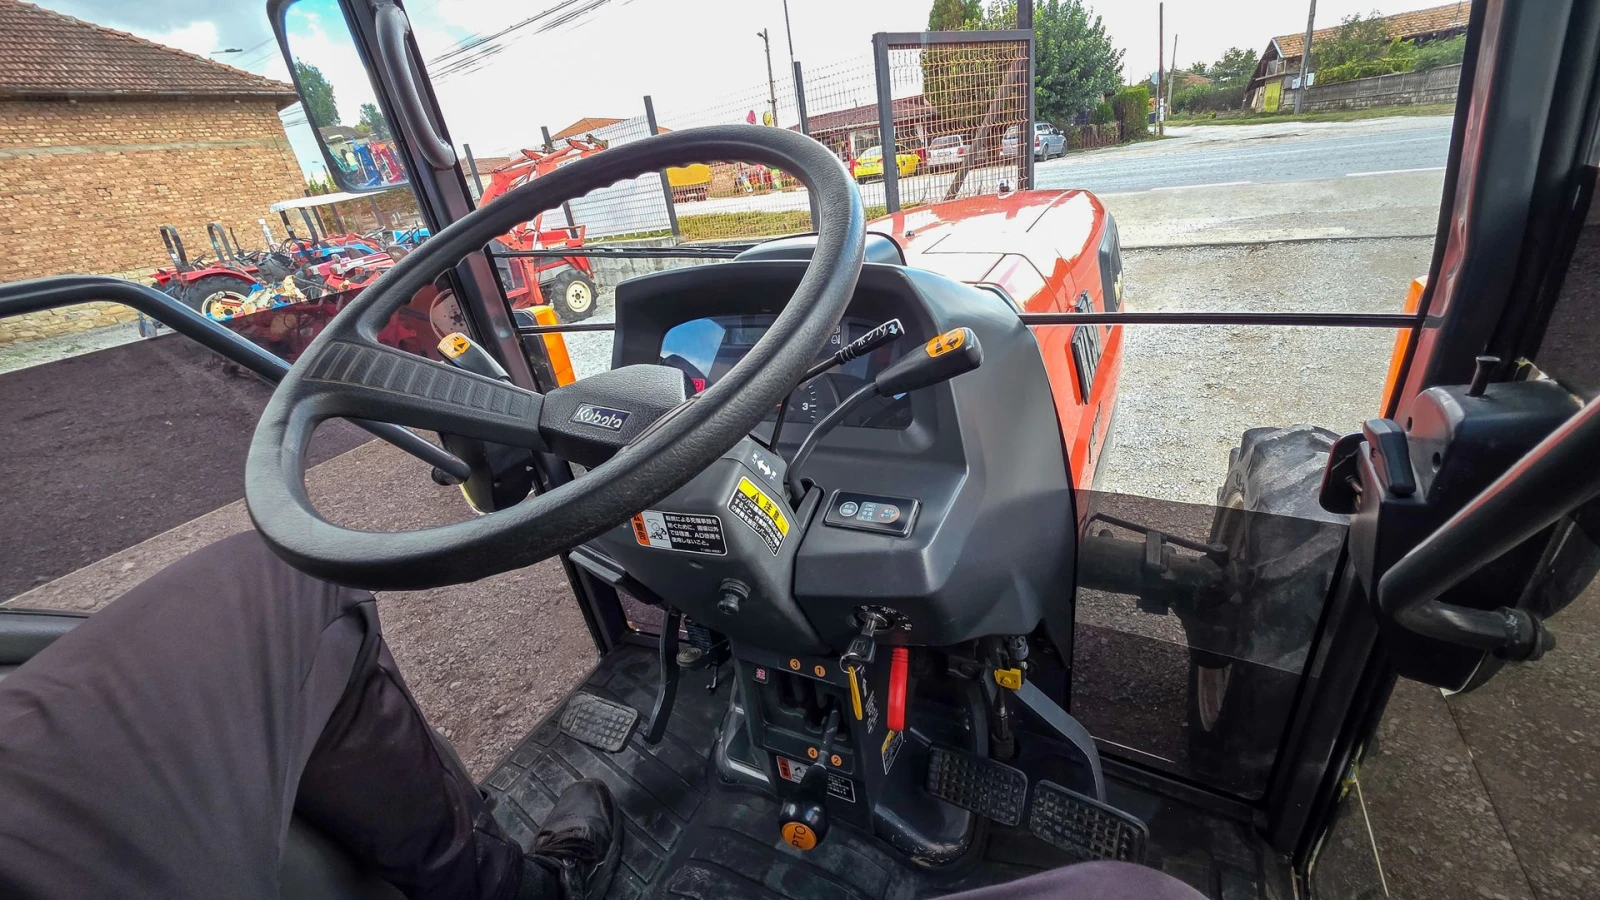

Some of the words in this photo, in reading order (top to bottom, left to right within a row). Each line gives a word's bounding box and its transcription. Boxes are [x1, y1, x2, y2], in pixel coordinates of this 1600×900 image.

[802, 403, 808, 411] 3
[576, 407, 623, 428] Kubota
[792, 660, 798, 668] 3
[809, 749, 815, 757] 4
[833, 756, 840, 764] 2
[791, 825, 807, 848] PTO
